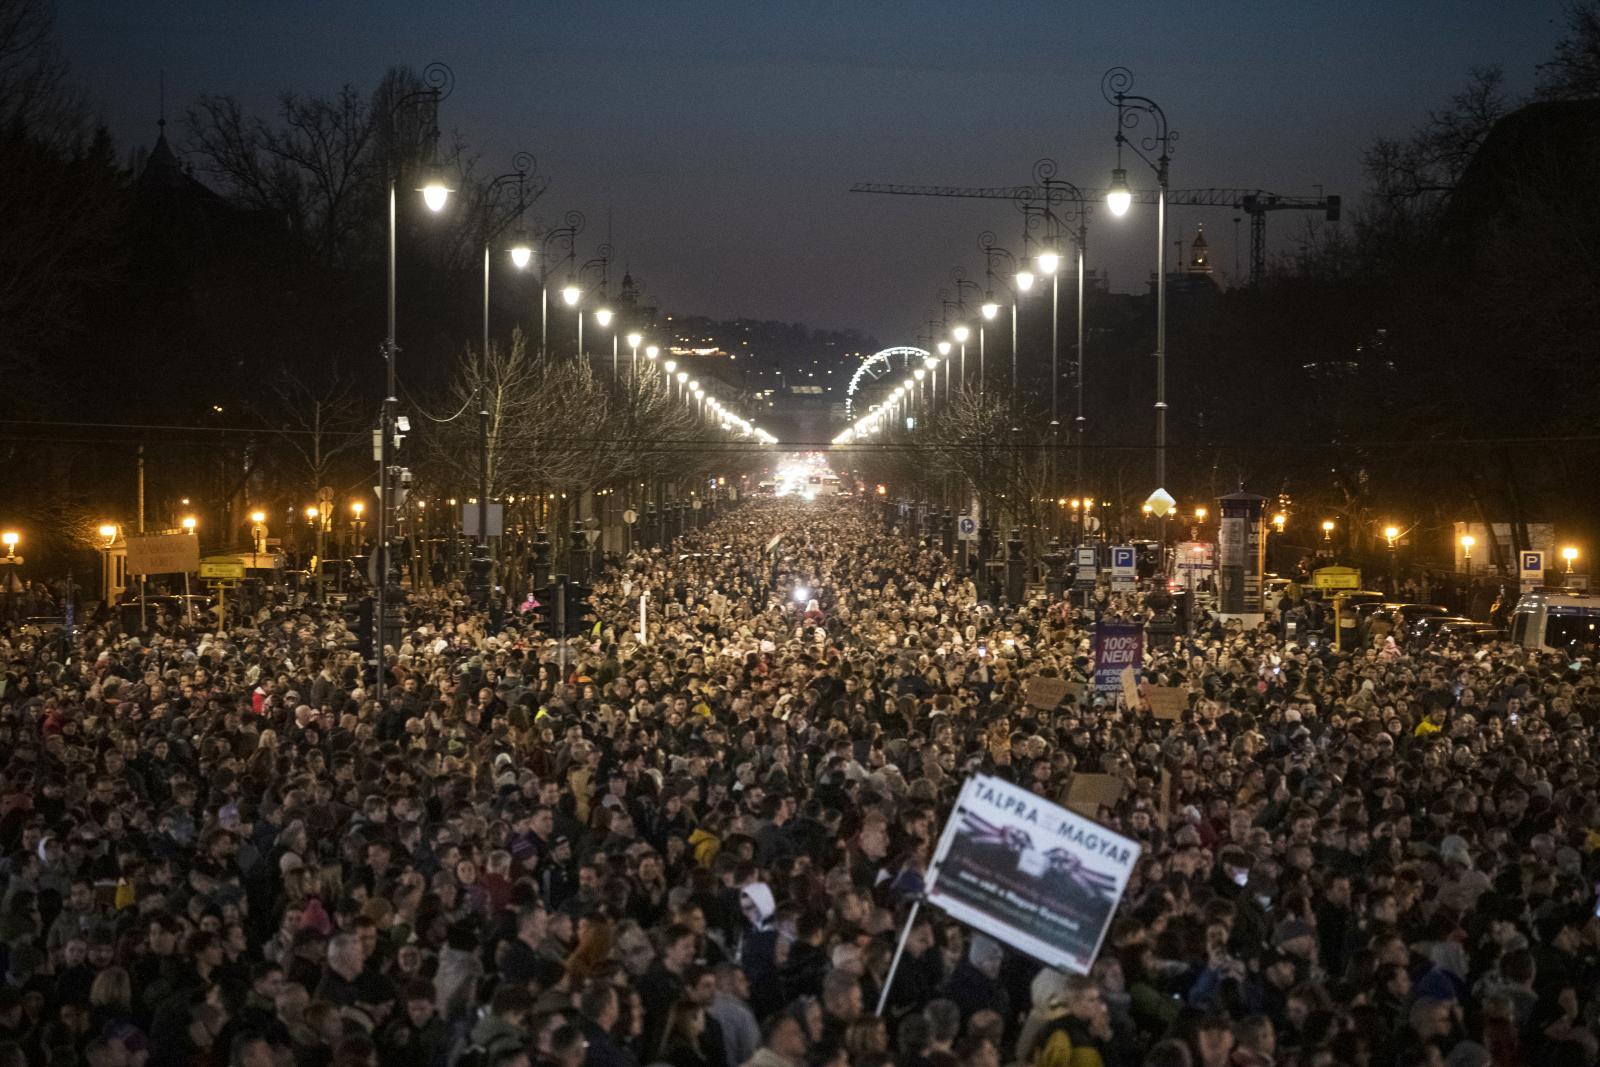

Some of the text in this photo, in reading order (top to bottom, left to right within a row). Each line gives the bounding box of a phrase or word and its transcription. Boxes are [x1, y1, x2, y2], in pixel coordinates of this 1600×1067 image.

[1118, 552, 1130, 565] P
[1526, 555, 1538, 568] P
[1104, 637, 1138, 650] 100%
[1102, 651, 1133, 663] NEM
[975, 782, 1131, 867] TALPRA MAGYAR
